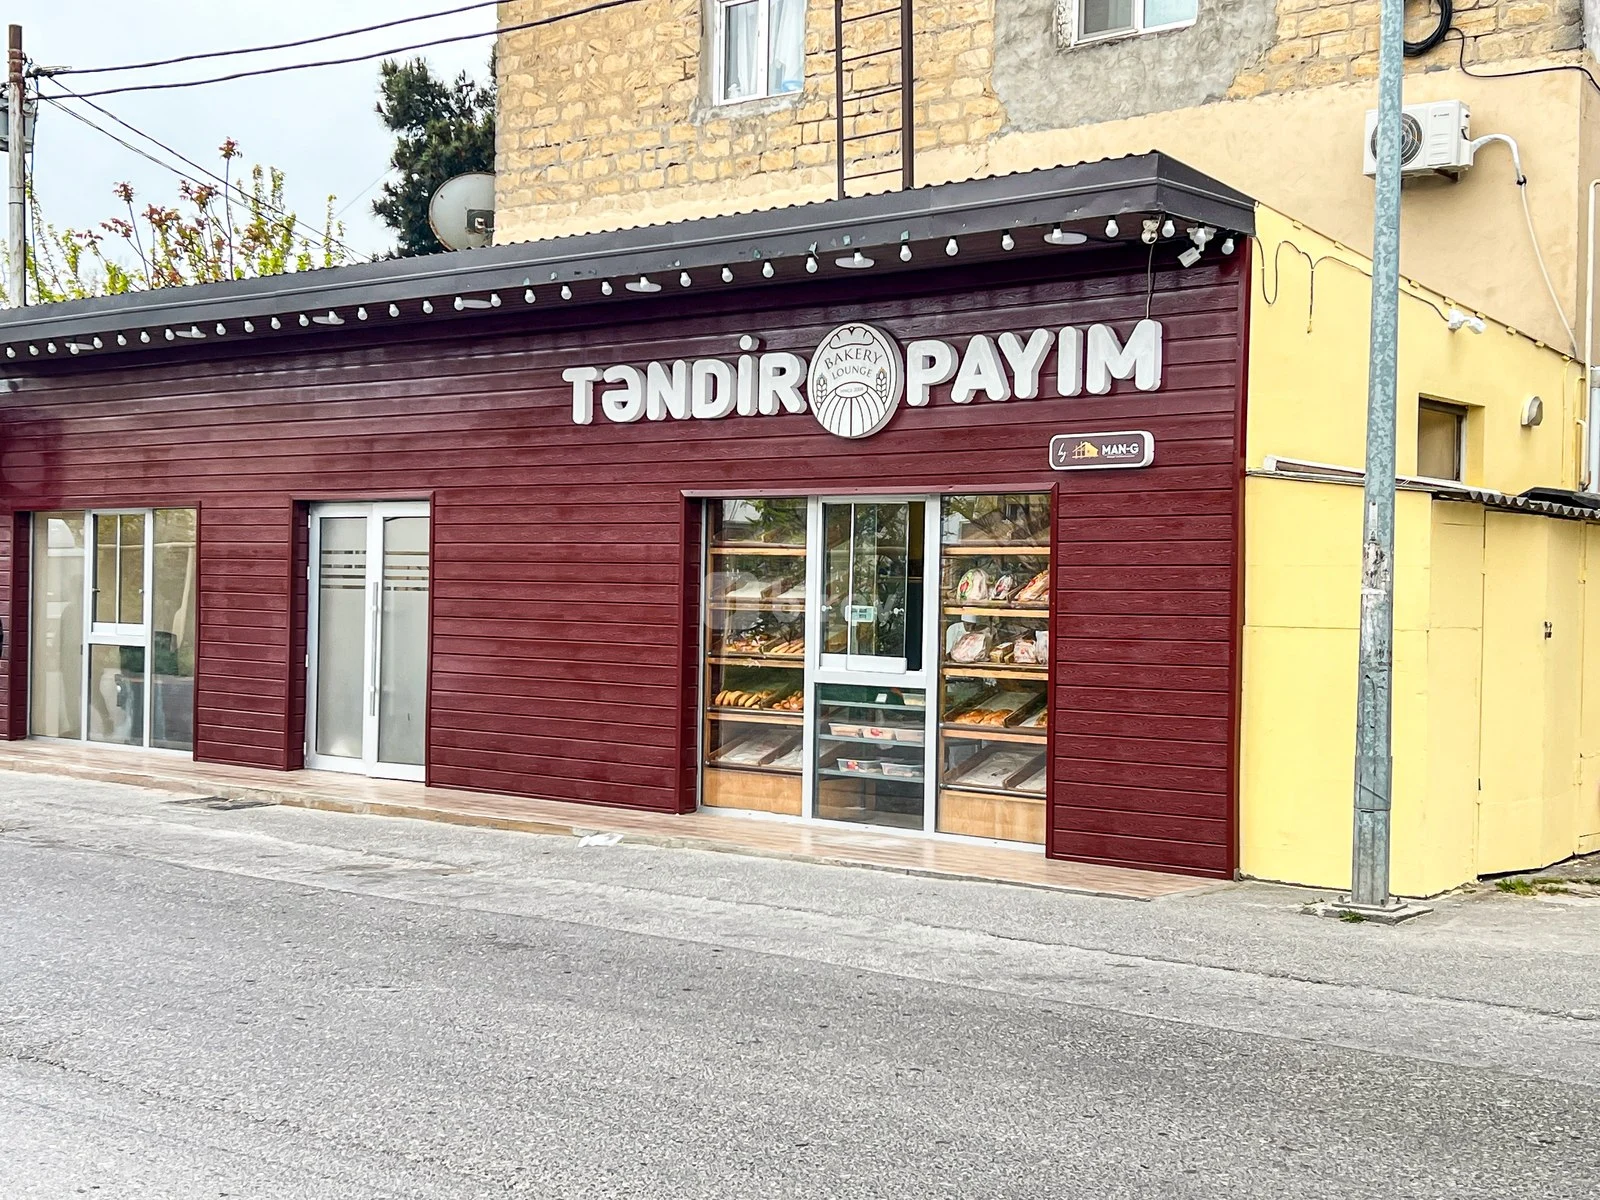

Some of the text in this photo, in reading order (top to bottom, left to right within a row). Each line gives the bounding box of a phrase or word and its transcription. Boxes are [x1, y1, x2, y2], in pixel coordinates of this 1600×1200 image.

[825, 348, 882, 369] BAKERY
[562, 318, 1163, 425] TƏNDİR PAYIM
[832, 366, 872, 380] LOUNGE
[1102, 444, 1139, 456] MAN-G
